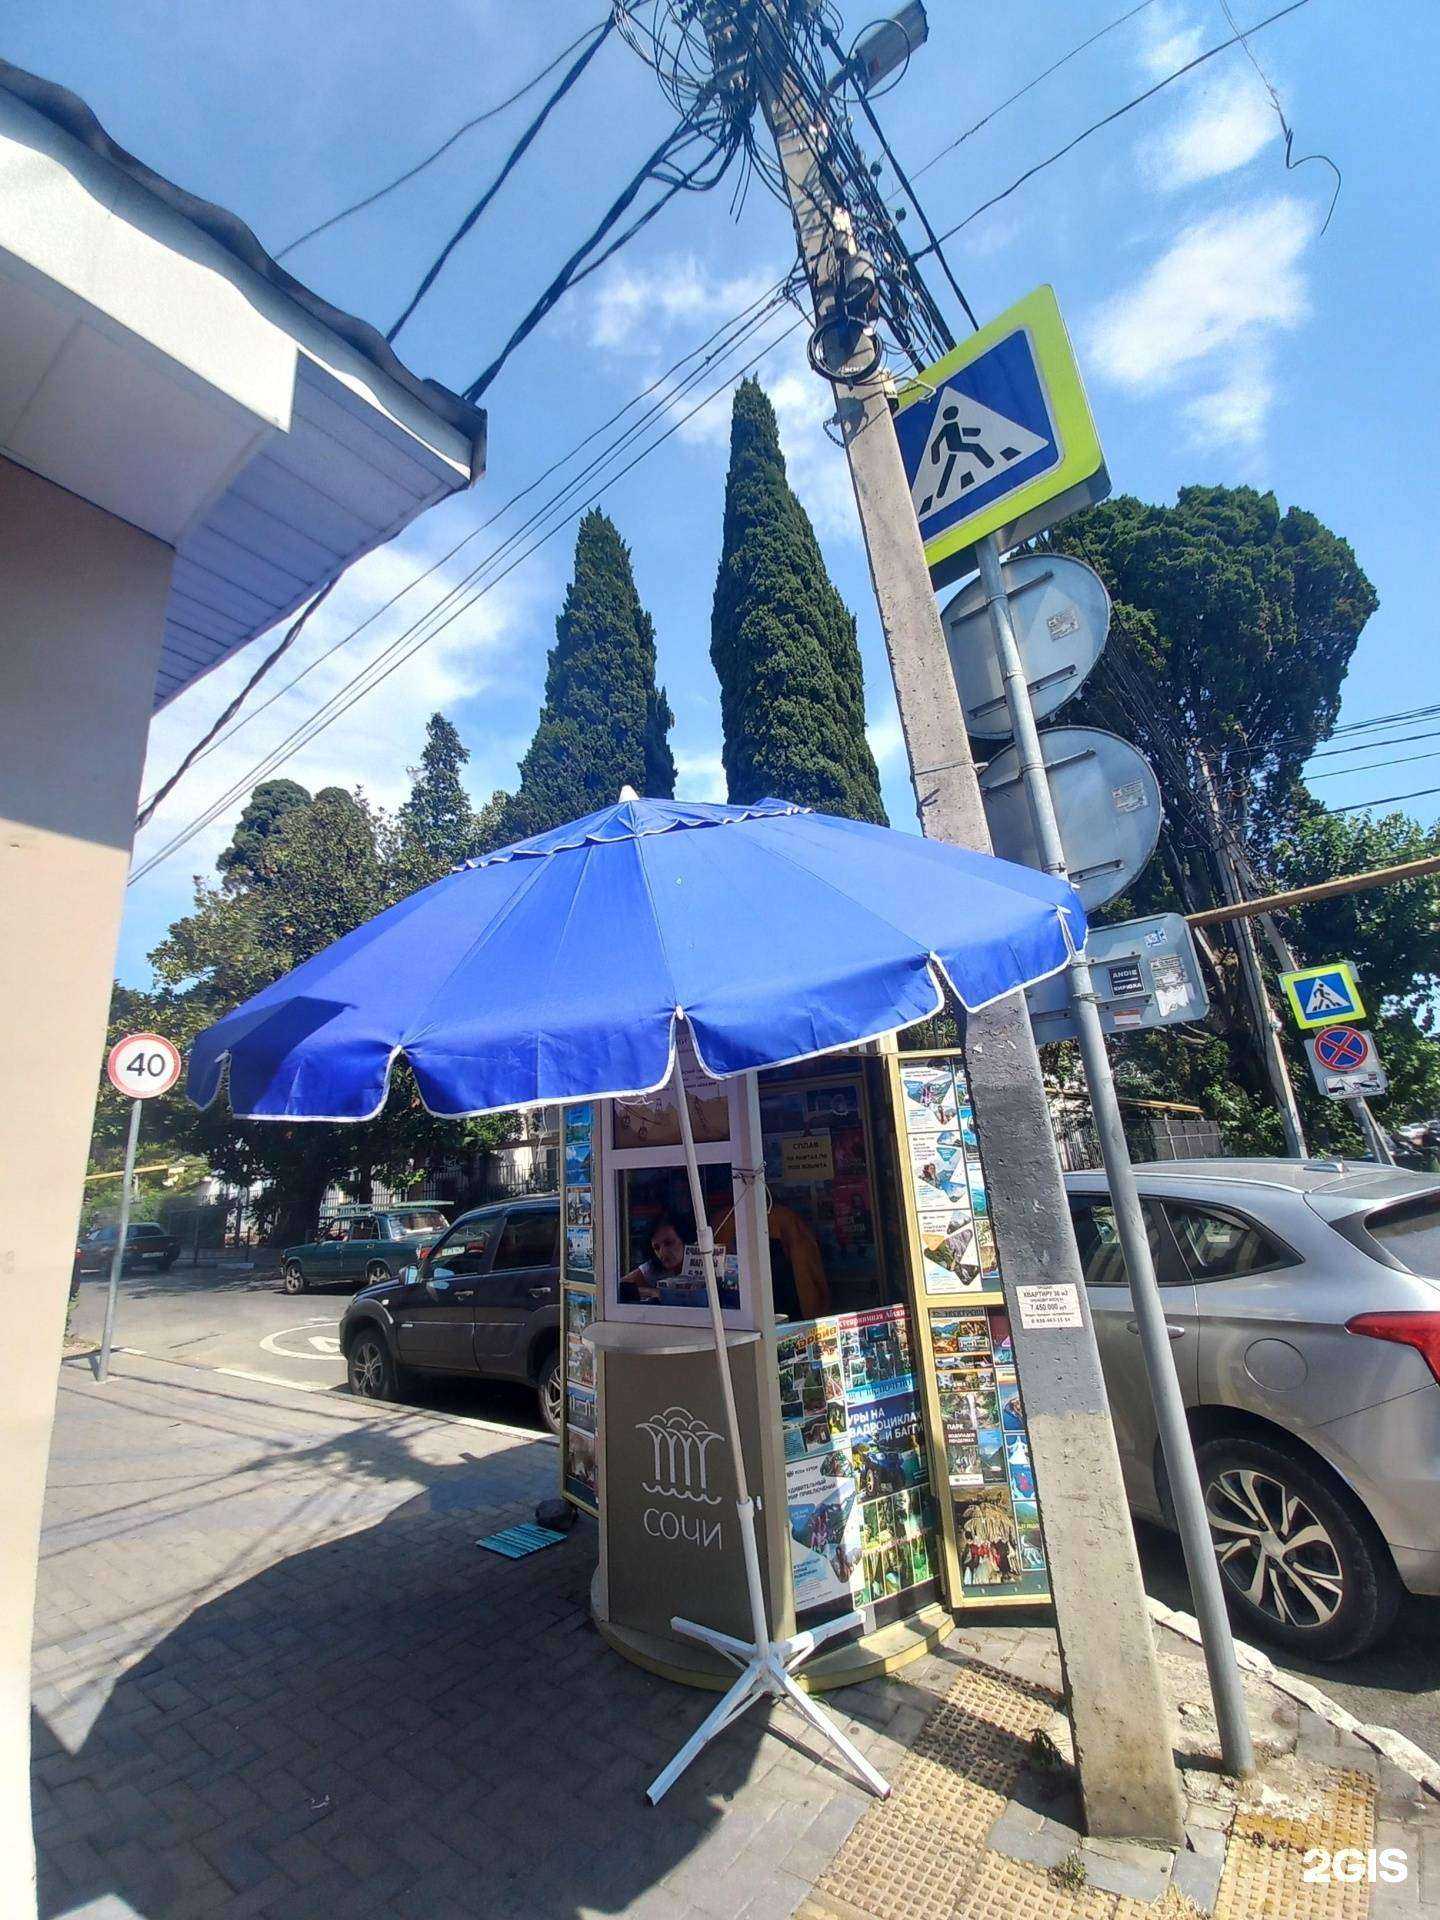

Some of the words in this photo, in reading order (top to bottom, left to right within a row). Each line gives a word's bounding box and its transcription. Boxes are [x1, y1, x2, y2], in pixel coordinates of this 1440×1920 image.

[126, 1052, 166, 1077] 40
[849, 1410, 869, 1425] УРЫ
[870, 1407, 885, 1420] НА
[849, 1410, 922, 1438] ВАДРОЦИКЛАХ
[895, 1421, 924, 1439] БАГГИ
[644, 1508, 722, 1550] СОЧИ
